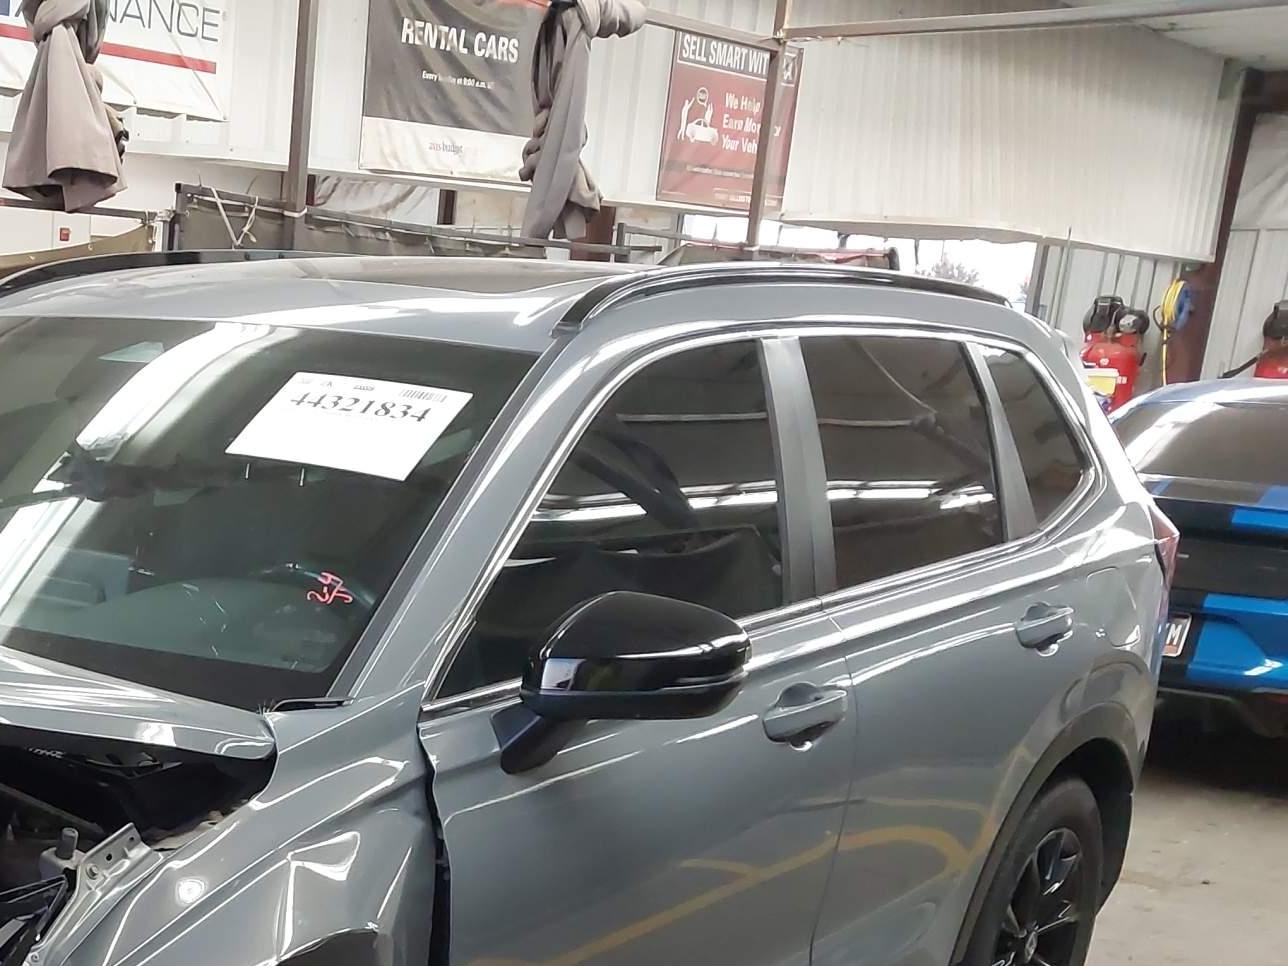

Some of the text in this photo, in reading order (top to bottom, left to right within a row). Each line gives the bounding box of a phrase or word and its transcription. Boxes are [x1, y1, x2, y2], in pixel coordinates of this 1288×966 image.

[401, 17, 519, 63] RENTAL CARS
[682, 34, 707, 63] SELL
[708, 40, 748, 71] SMART
[725, 92, 739, 110] We
[740, 95, 761, 116] Help
[722, 113, 744, 131] Earn
[722, 133, 740, 152] Your
[290, 391, 432, 423] 44321834
